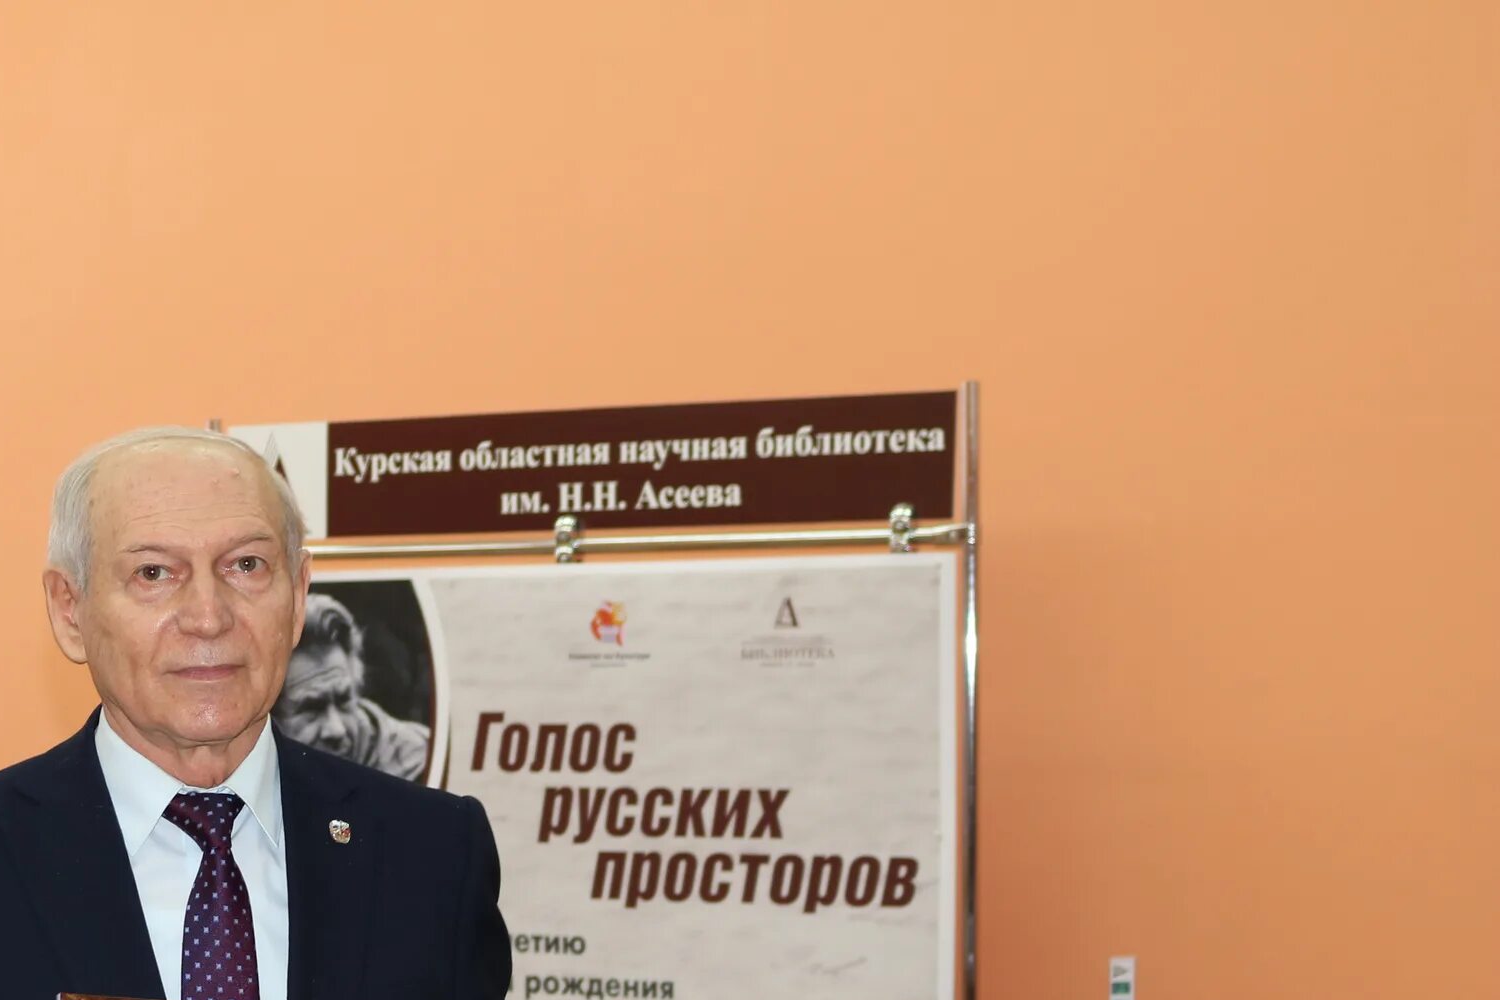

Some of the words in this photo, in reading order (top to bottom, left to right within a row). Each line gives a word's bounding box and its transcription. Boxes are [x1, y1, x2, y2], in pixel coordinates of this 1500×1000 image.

[334, 446, 452, 484] Курская
[458, 440, 611, 471] областная
[619, 436, 748, 471] научная
[755, 424, 946, 459] библиотека
[500, 491, 551, 515] им.
[558, 481, 627, 513] Н.Н.
[634, 480, 742, 510] Асеева
[471, 712, 636, 773] Голос
[538, 786, 790, 843] русских
[591, 851, 918, 914] просторов
[509, 934, 586, 956] етию
[525, 976, 674, 1000] рождения
